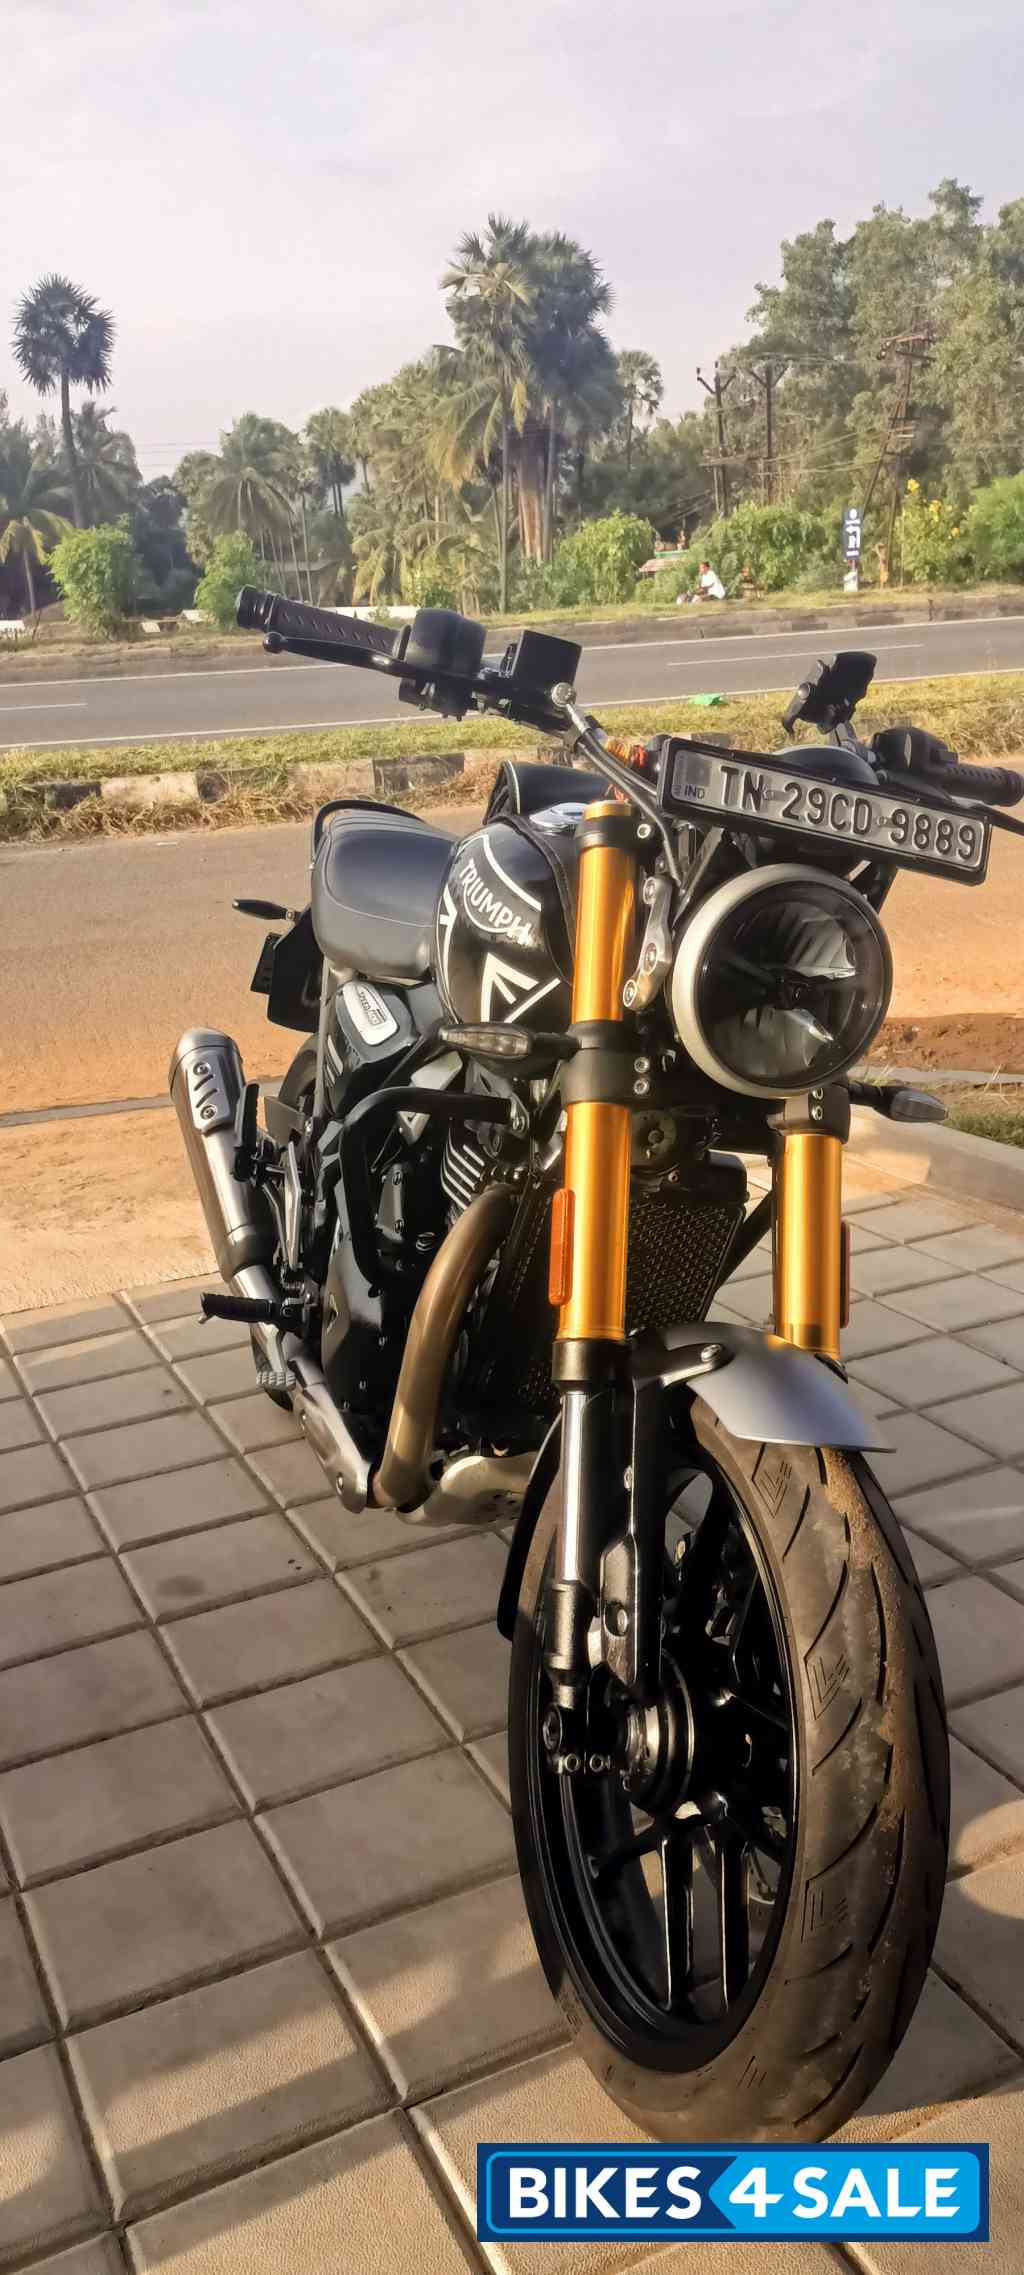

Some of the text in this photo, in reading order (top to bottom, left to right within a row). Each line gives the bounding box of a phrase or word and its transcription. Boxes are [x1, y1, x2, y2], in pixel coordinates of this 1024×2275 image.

[684, 784, 705, 800] IND
[718, 765, 977, 862] TN 29CD 9889
[458, 857, 535, 946] TRIUMPH
